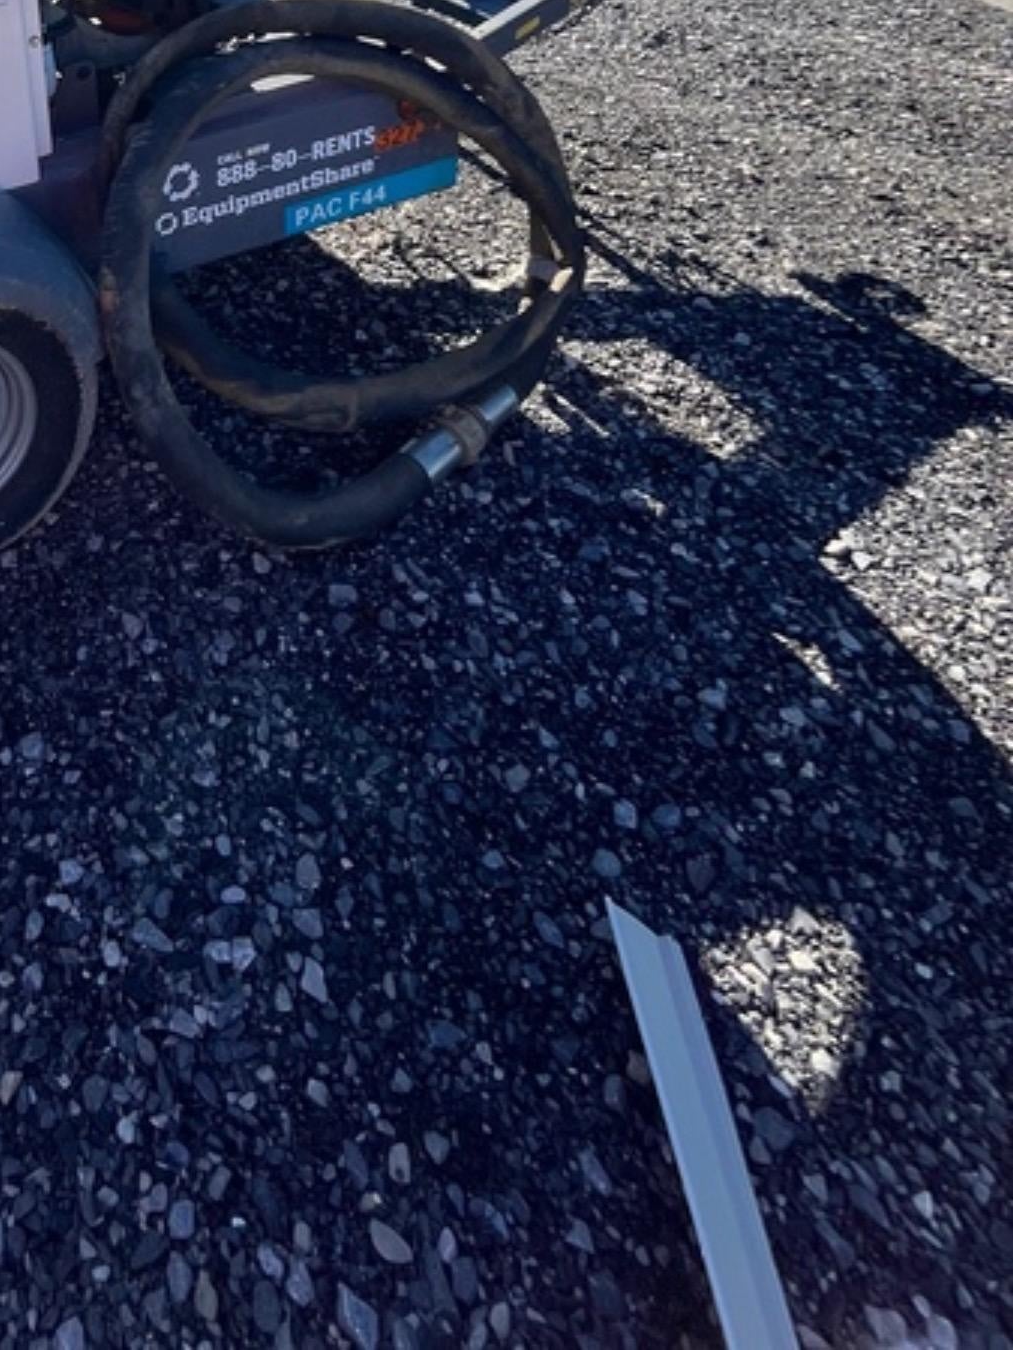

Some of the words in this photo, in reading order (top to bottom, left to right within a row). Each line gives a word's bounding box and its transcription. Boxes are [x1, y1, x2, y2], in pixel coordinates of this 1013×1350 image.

[180, 159, 376, 228] EquipmentShare
[294, 197, 343, 227] PAC
[348, 184, 388, 213] F44
